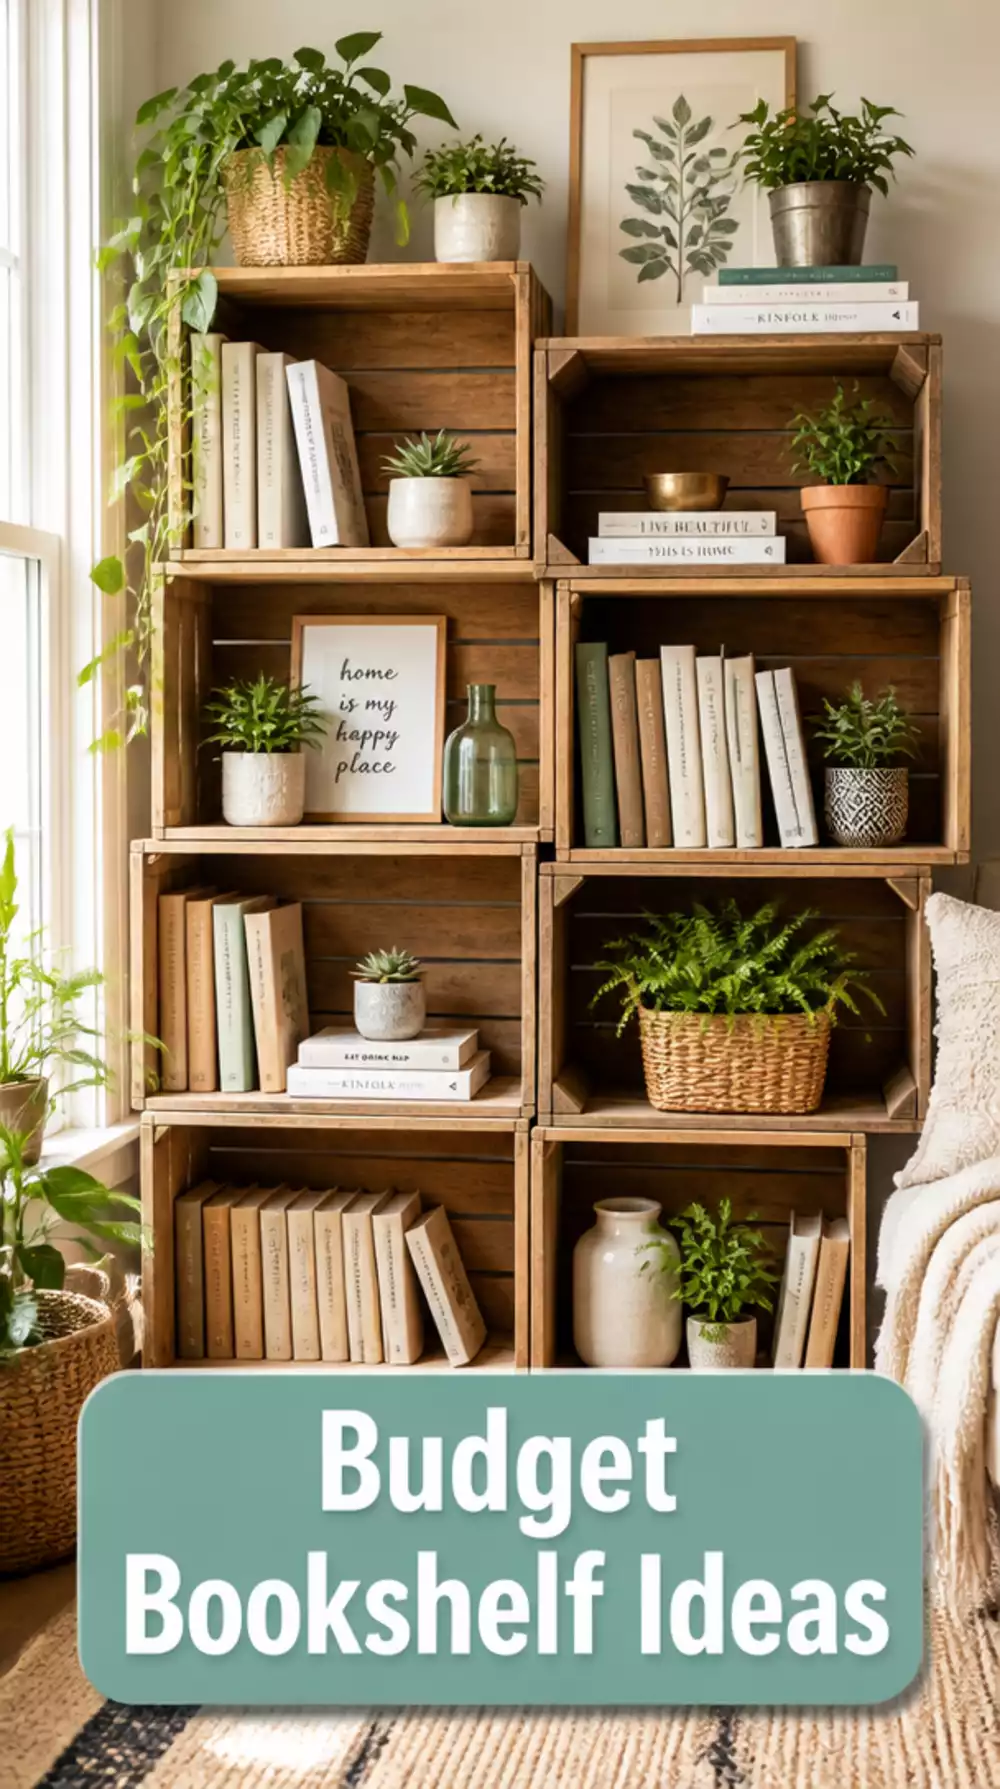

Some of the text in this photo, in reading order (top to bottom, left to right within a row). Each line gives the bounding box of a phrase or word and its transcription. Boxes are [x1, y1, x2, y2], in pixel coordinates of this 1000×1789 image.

[757, 312, 819, 324] KINFOLK
[340, 657, 398, 681] home
[339, 693, 397, 722] is my
[336, 719, 400, 751] happy
[334, 752, 396, 784] place
